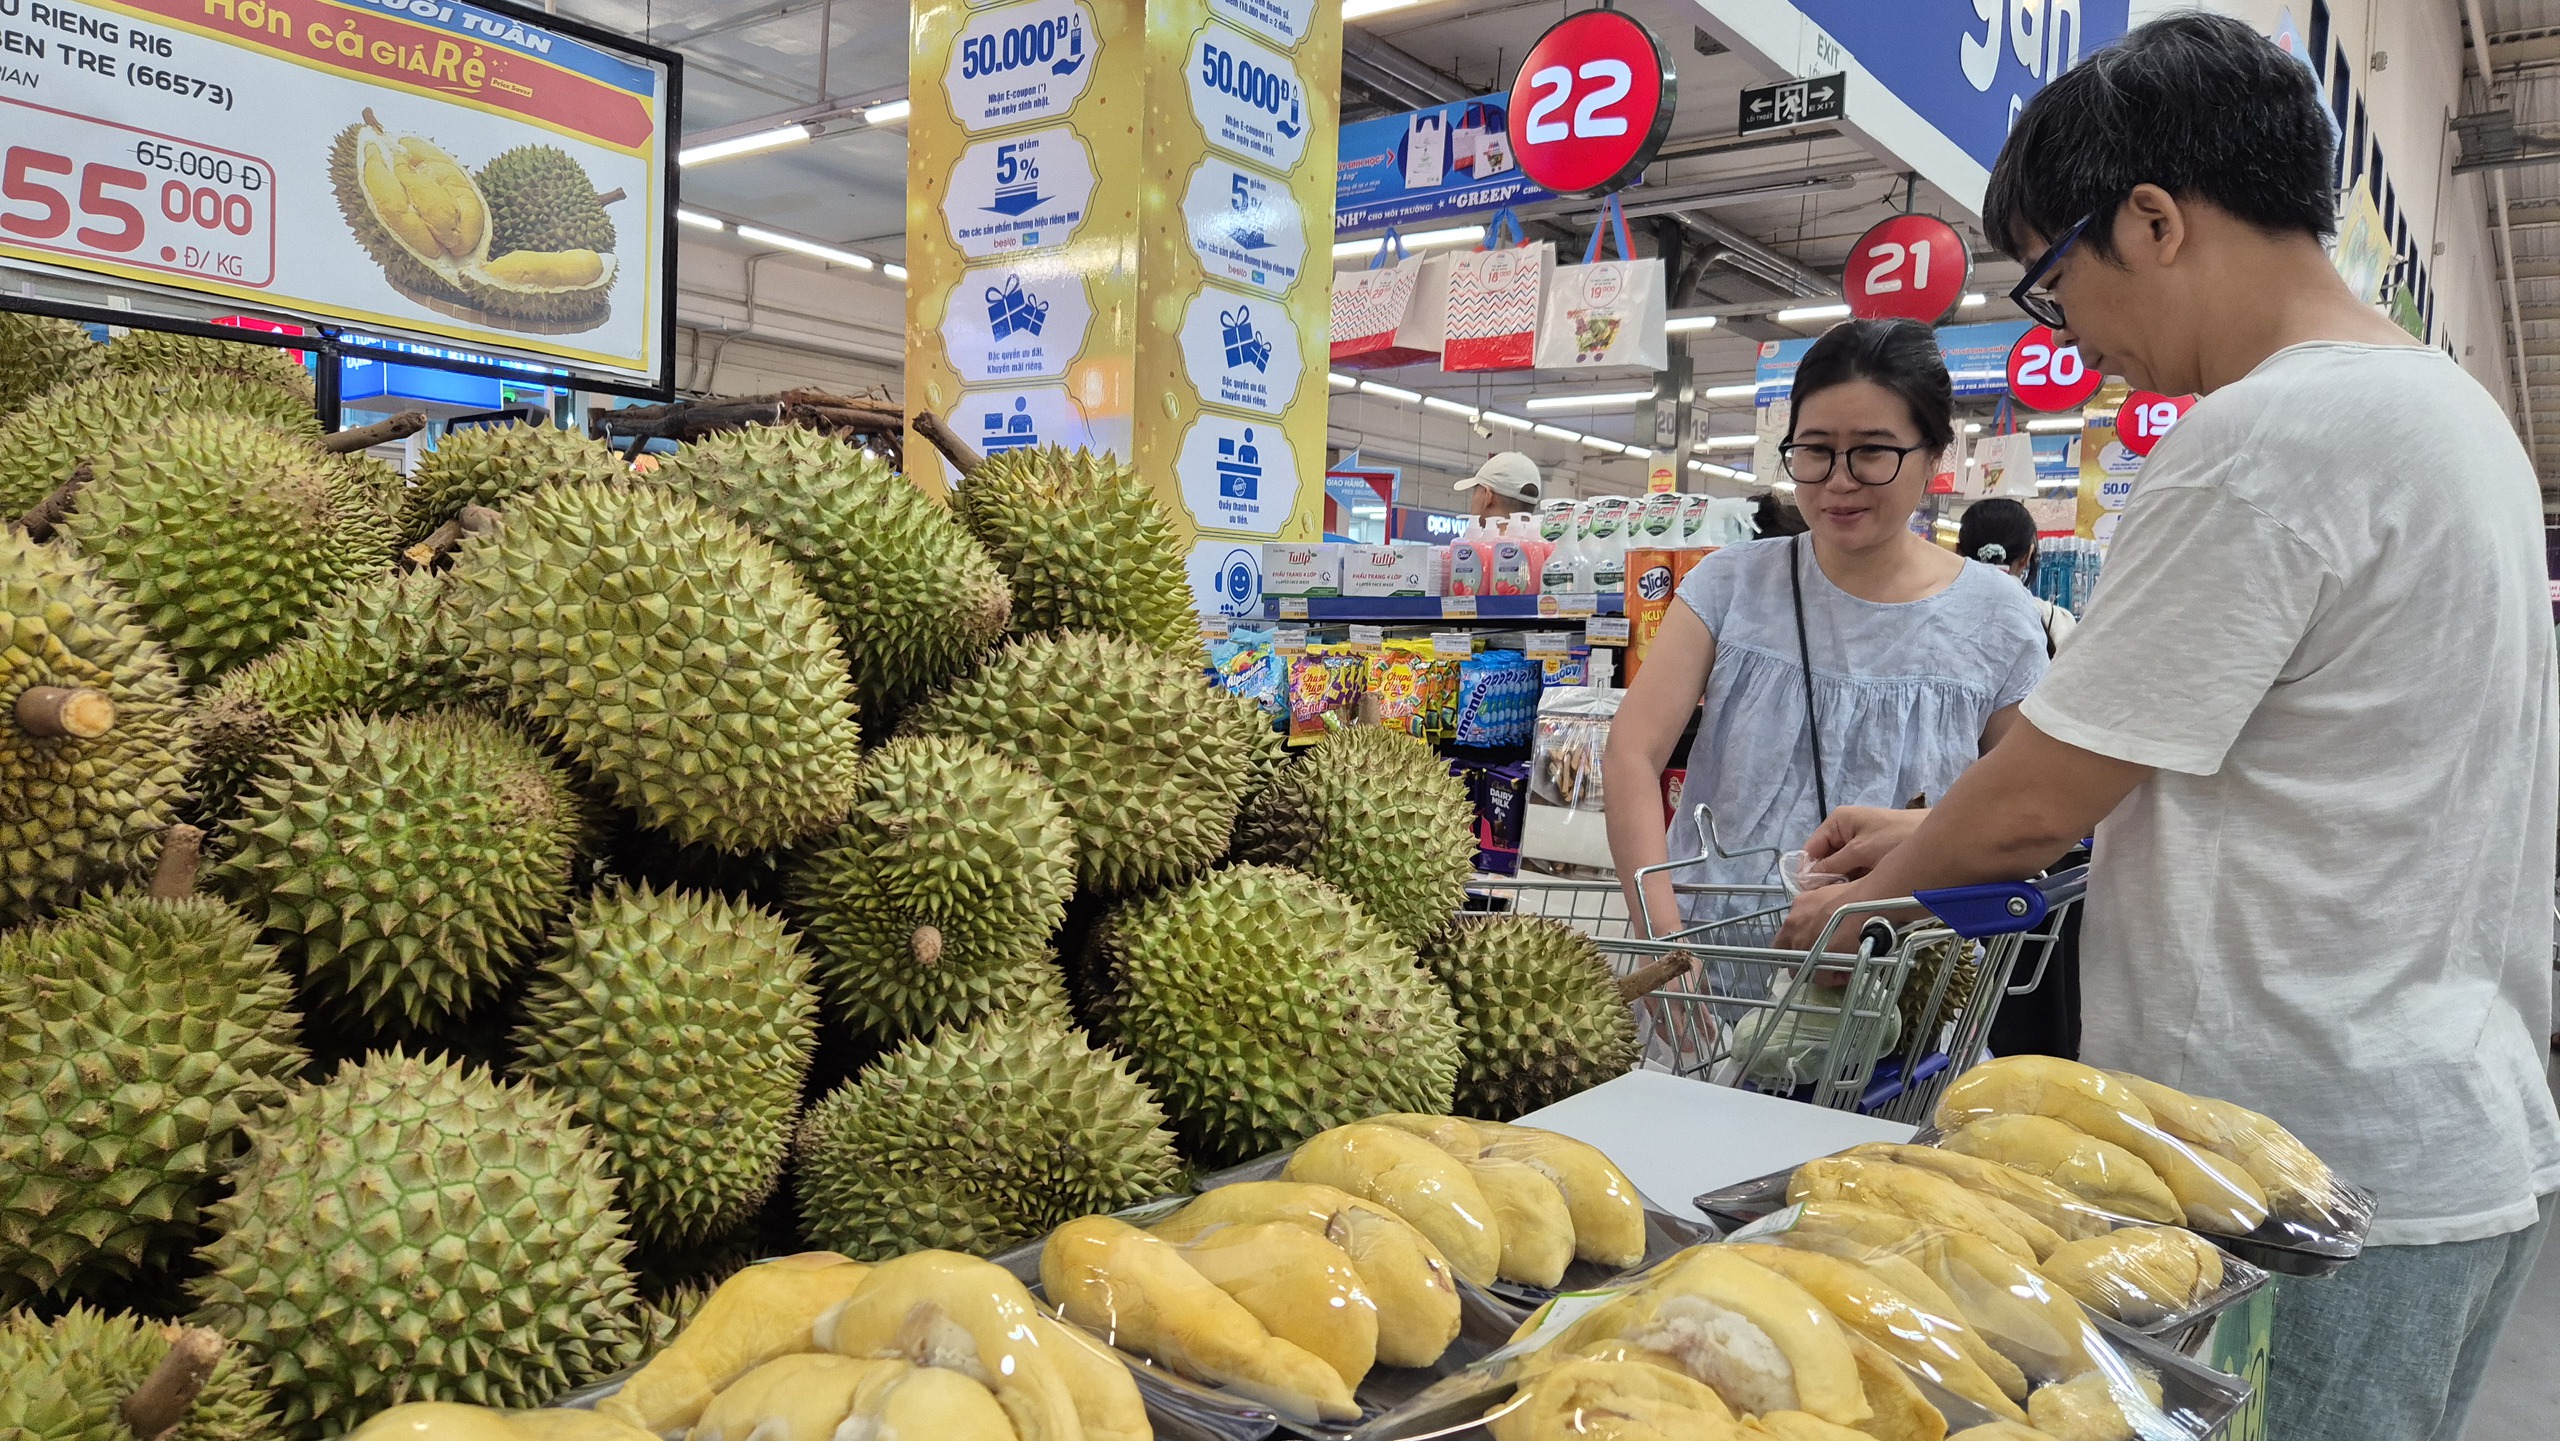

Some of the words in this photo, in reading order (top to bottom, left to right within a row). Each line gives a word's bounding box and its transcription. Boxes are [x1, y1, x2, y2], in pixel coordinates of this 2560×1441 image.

[31, 2, 119, 44] RIENG
[129, 29, 173, 58] RI6
[462, 12, 553, 55] TUẦN
[306, 19, 364, 59] cả
[370, 43, 430, 75] GIÁ
[431, 40, 487, 88] Rẻ
[1817, 32, 1840, 70] EXIT
[0, 29, 45, 59] EN
[57, 43, 116, 78] TRE
[127, 62, 234, 111] (66573)
[0, 65, 40, 89] IAN
[1006, 85, 1037, 100] E-coupon
[1526, 59, 1633, 145] 22
[1808, 101, 1836, 112] EXIT
[136, 140, 233, 185] 65.000
[241, 166, 262, 191] Đ
[1368, 213, 1383, 221] CHO
[217, 253, 243, 276] KG
[1865, 240, 1931, 295] 21
[2016, 344, 2083, 387] 20
[1658, 410, 1675, 435] 20
[2134, 401, 2178, 438] 19
[1326, 478, 1343, 488] GIAO
[1344, 477, 1364, 488] HÀNG
[1428, 514, 1450, 536] DỊCH
[1638, 568, 1670, 599] Slide
[1303, 673, 1327, 683] Chupa
[1386, 671, 1412, 681] Chupa
[1543, 663, 1580, 683] MELODY
[1301, 682, 1325, 695] Chups
[1384, 681, 1409, 697] Chups
[1458, 673, 1492, 739] mentos
[1489, 787, 1514, 801] DAIRY
[1491, 796, 1510, 810] MILK
